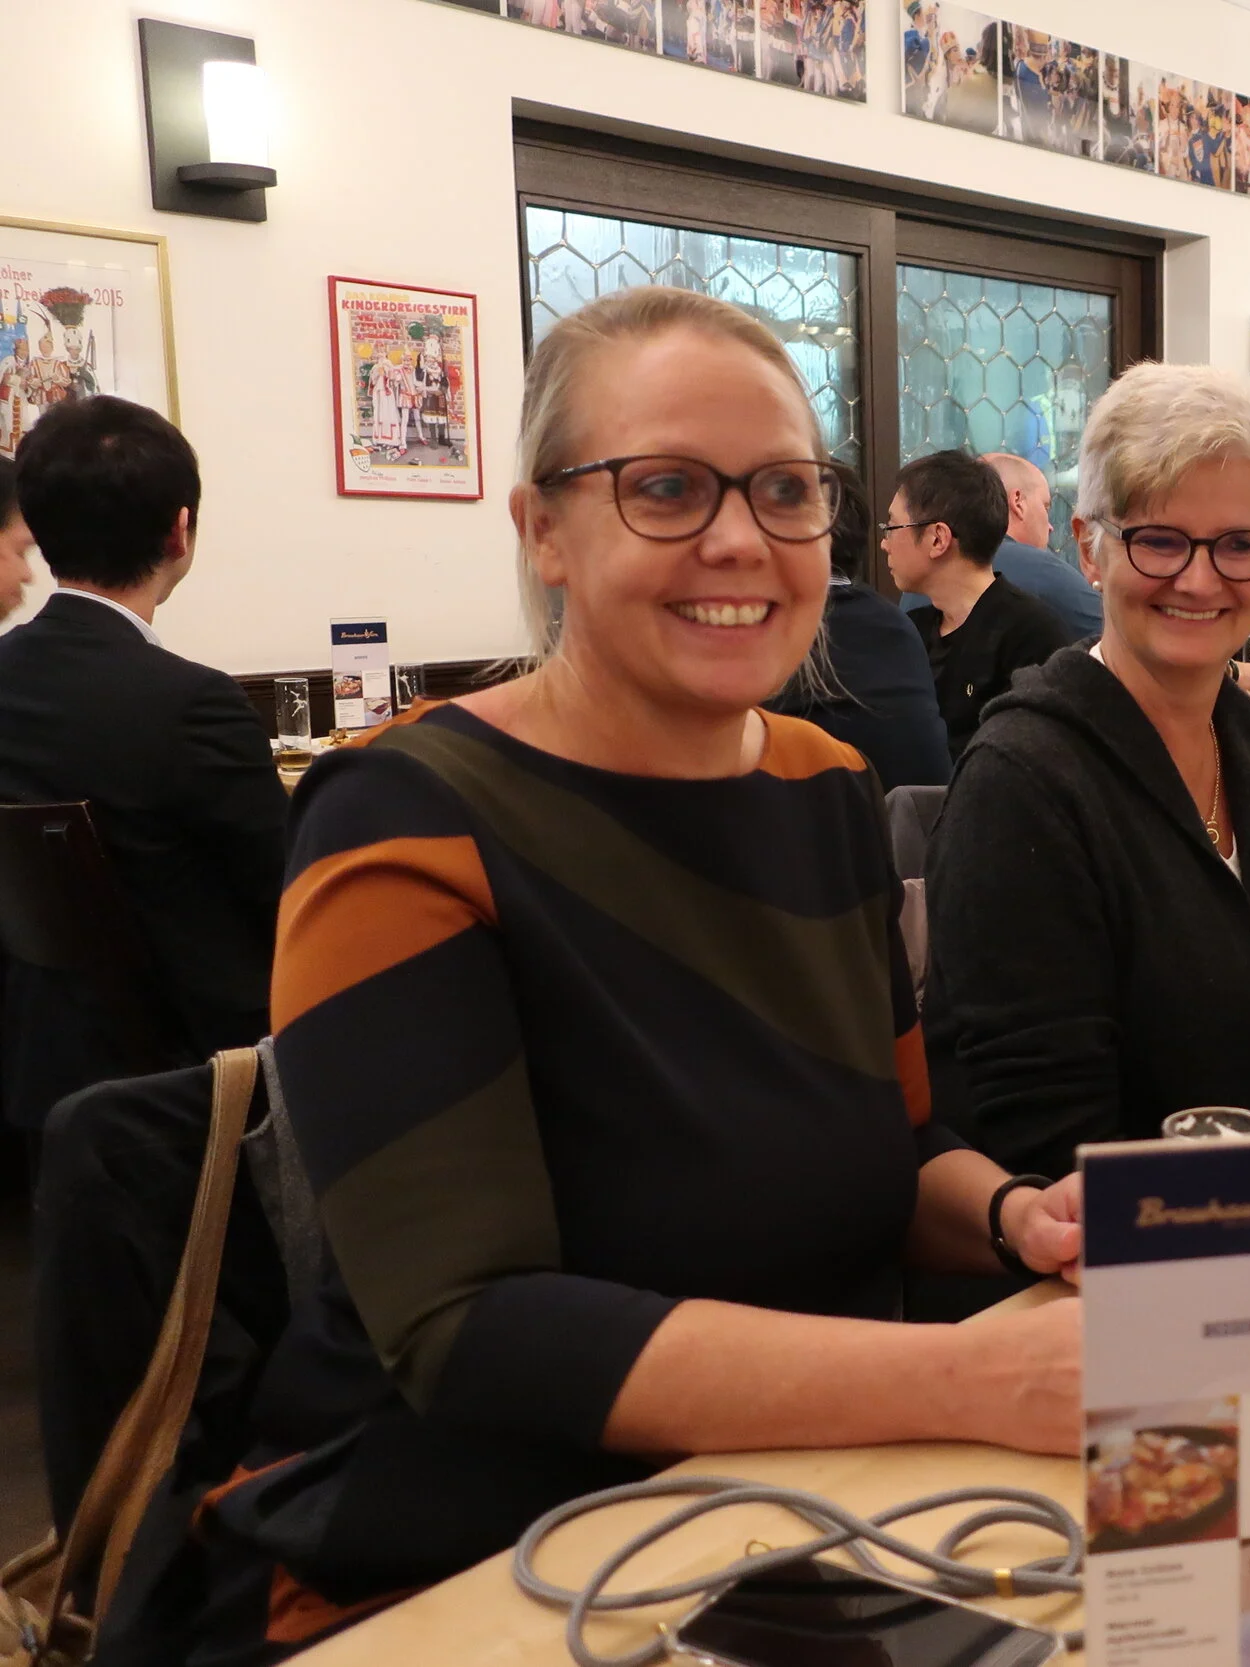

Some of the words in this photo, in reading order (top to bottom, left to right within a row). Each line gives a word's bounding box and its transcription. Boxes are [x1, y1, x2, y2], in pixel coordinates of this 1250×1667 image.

[0, 264, 33, 281] ölner
[94, 287, 124, 307] 2015
[341, 299, 468, 316] KINDERDREIGESTIRN
